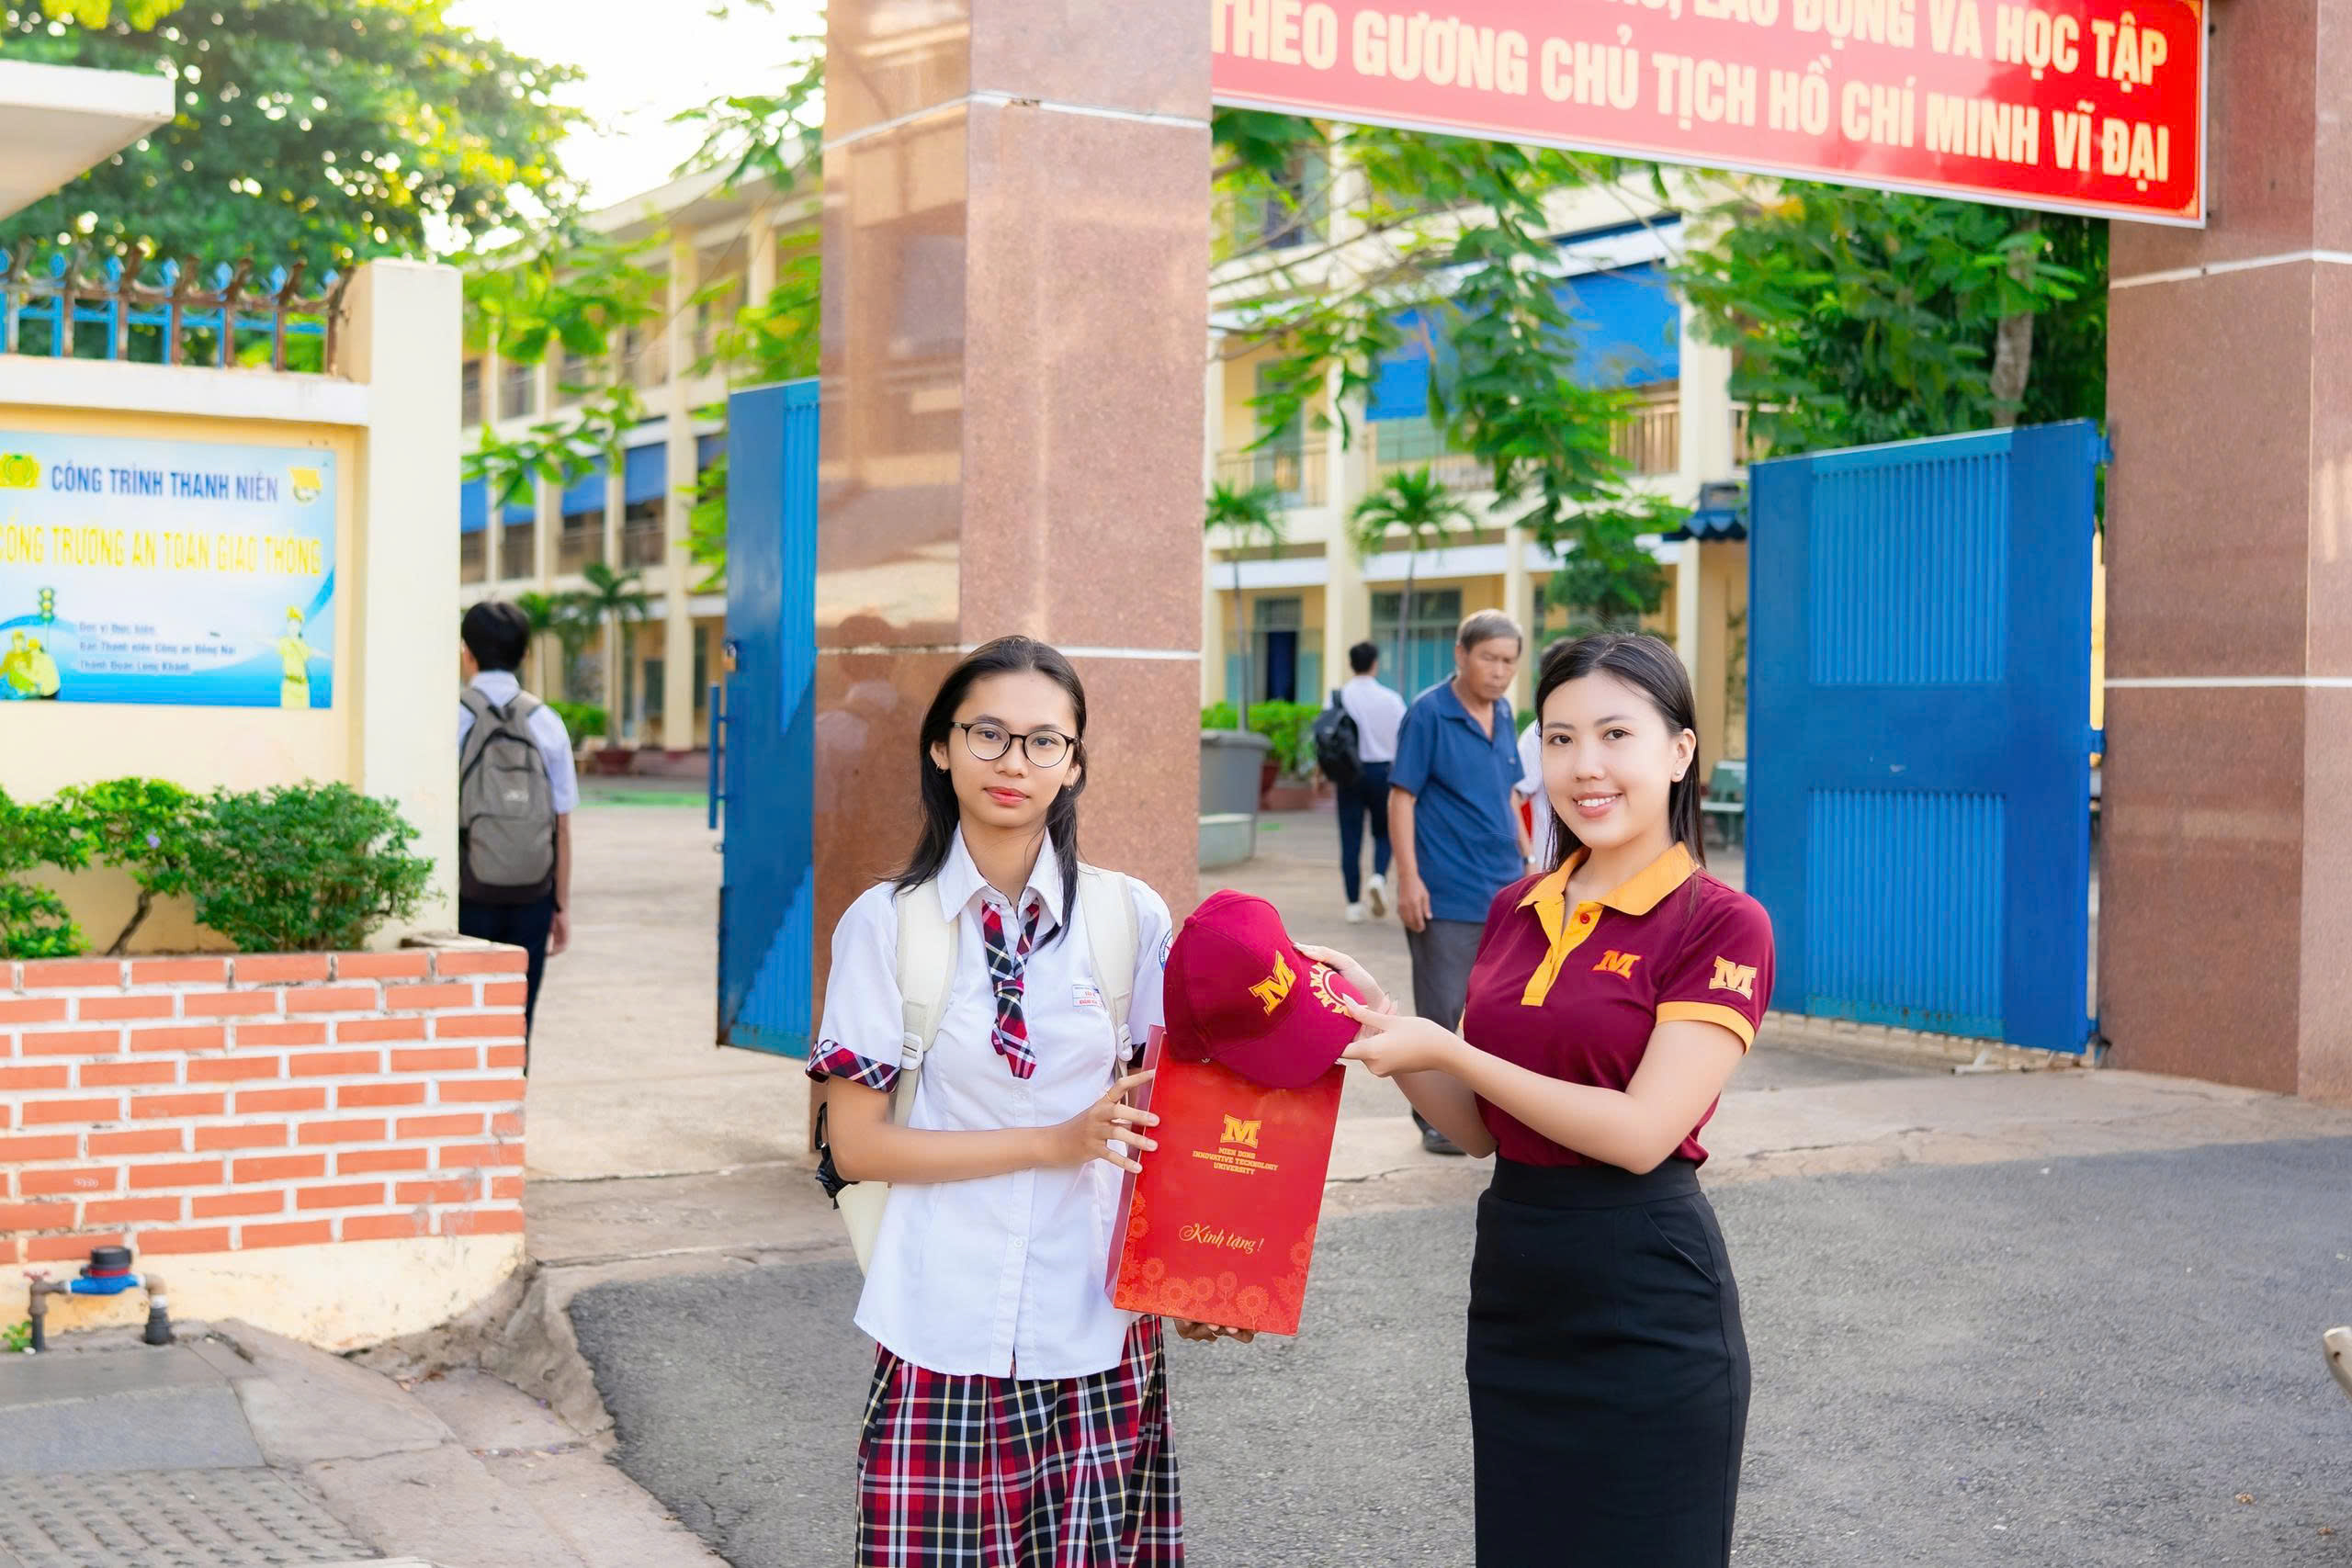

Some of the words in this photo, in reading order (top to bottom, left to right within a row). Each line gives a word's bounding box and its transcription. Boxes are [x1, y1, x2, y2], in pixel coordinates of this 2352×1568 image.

[1996, 4, 2079, 81] HỌC
[2091, 11, 2168, 93] TẬP
[1212, 0, 1338, 71] THEO
[1352, 9, 1529, 96] GƯƠNG
[1541, 24, 1639, 110] CHỦ
[1651, 51, 1757, 130] TỊCH
[1769, 54, 1832, 136] HỒ
[1841, 76, 1917, 148] CHÍ
[1926, 93, 2040, 165] MINH
[2052, 100, 2096, 173] VĨ
[2101, 118, 2170, 191] ĐẠI
[170, 471, 230, 500] THANH
[131, 530, 158, 570] AN
[1591, 949, 1642, 980] M
[1708, 955, 1757, 1000] M
[1249, 950, 1296, 1016] M
[1220, 1114, 1261, 1148] M
[1193, 1150, 1234, 1164] INNOVATIVE
[1234, 1157, 1279, 1171] TECHNOLOGY
[1213, 1161, 1256, 1175] UNIVERSITY
[1179, 1223, 1225, 1248] Kính
